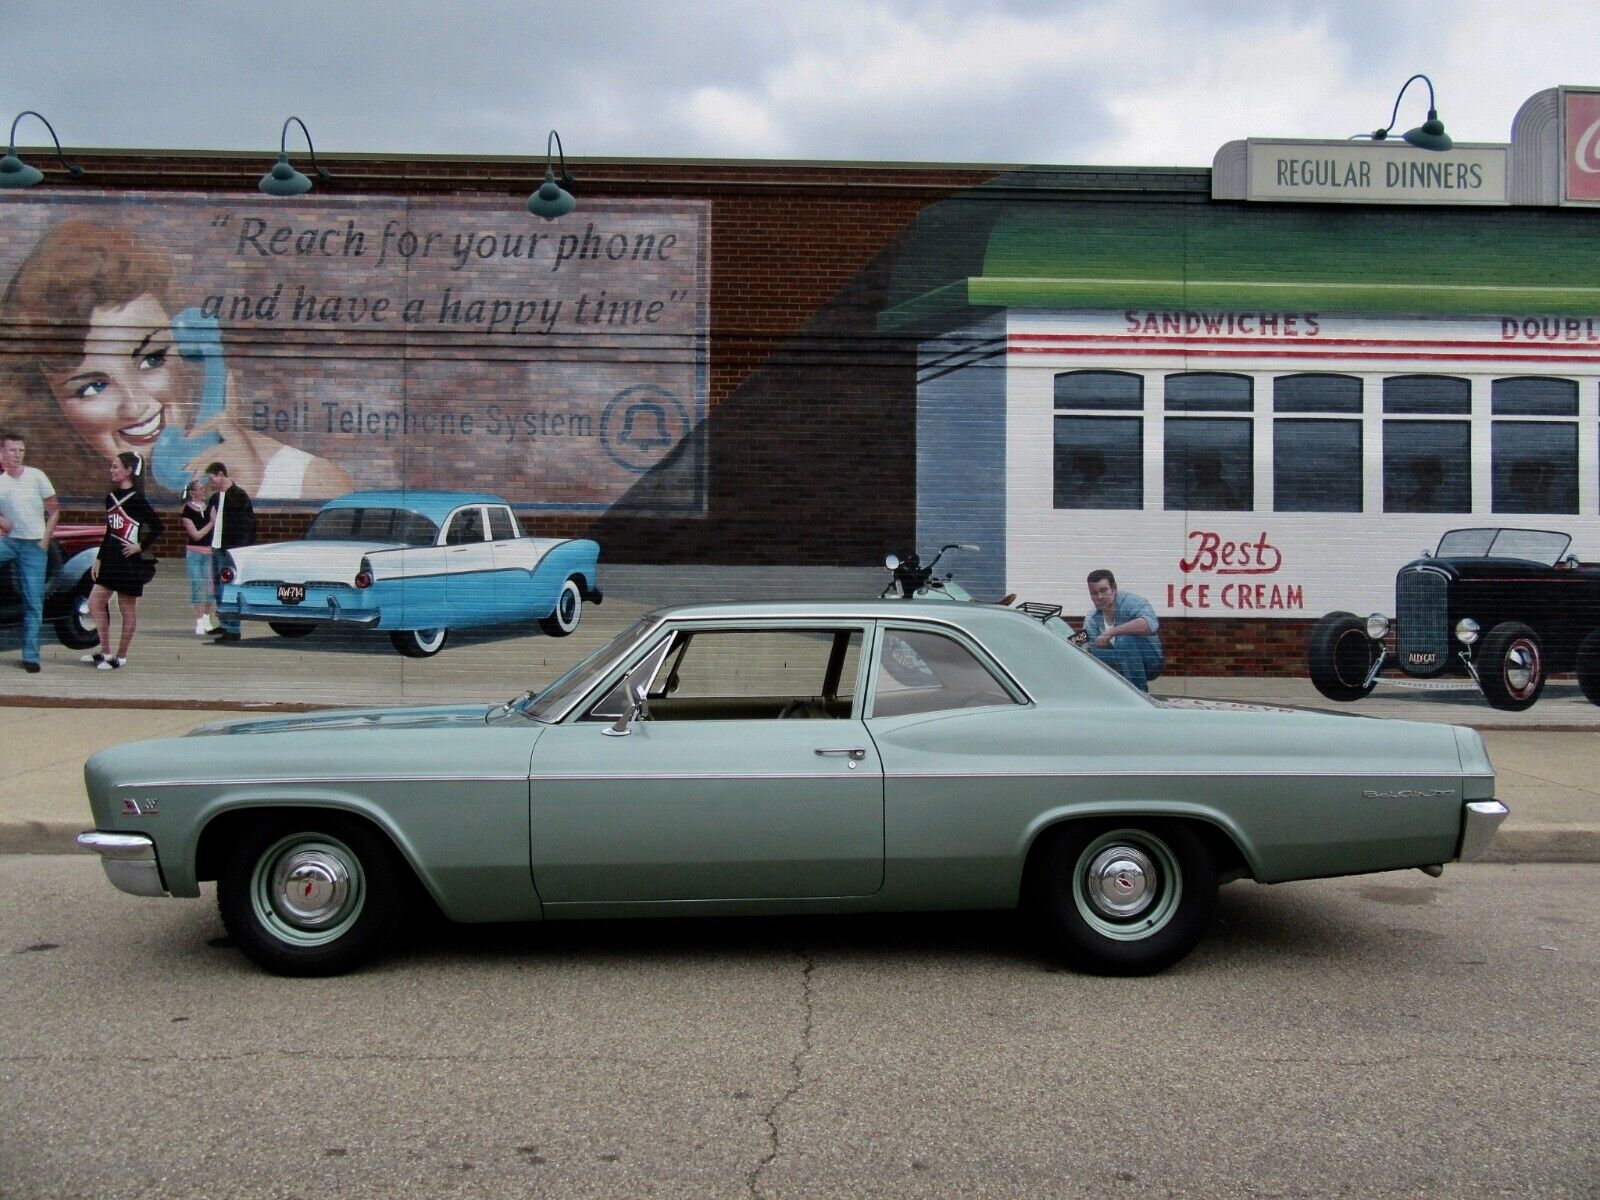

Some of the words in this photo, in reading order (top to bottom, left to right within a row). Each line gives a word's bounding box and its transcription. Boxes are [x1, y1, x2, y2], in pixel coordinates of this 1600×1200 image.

[1276, 159, 1371, 188] REGULAR
[1386, 161, 1483, 189] DINNERS
[374, 219, 443, 268] for
[450, 231, 548, 271] your
[552, 222, 678, 272] phone
[201, 283, 283, 321] and
[292, 285, 390, 322] have
[402, 299, 425, 324] a
[438, 287, 563, 335] happy
[1124, 310, 1321, 337] SANDWICHES
[1501, 316, 1600, 341] DOUBL
[252, 401, 309, 433] Bell
[321, 402, 474, 440] Telephone
[486, 405, 593, 444] System
[1180, 531, 1281, 574] Best
[1167, 583, 1210, 608] ICE
[1221, 583, 1304, 609] CREAM
